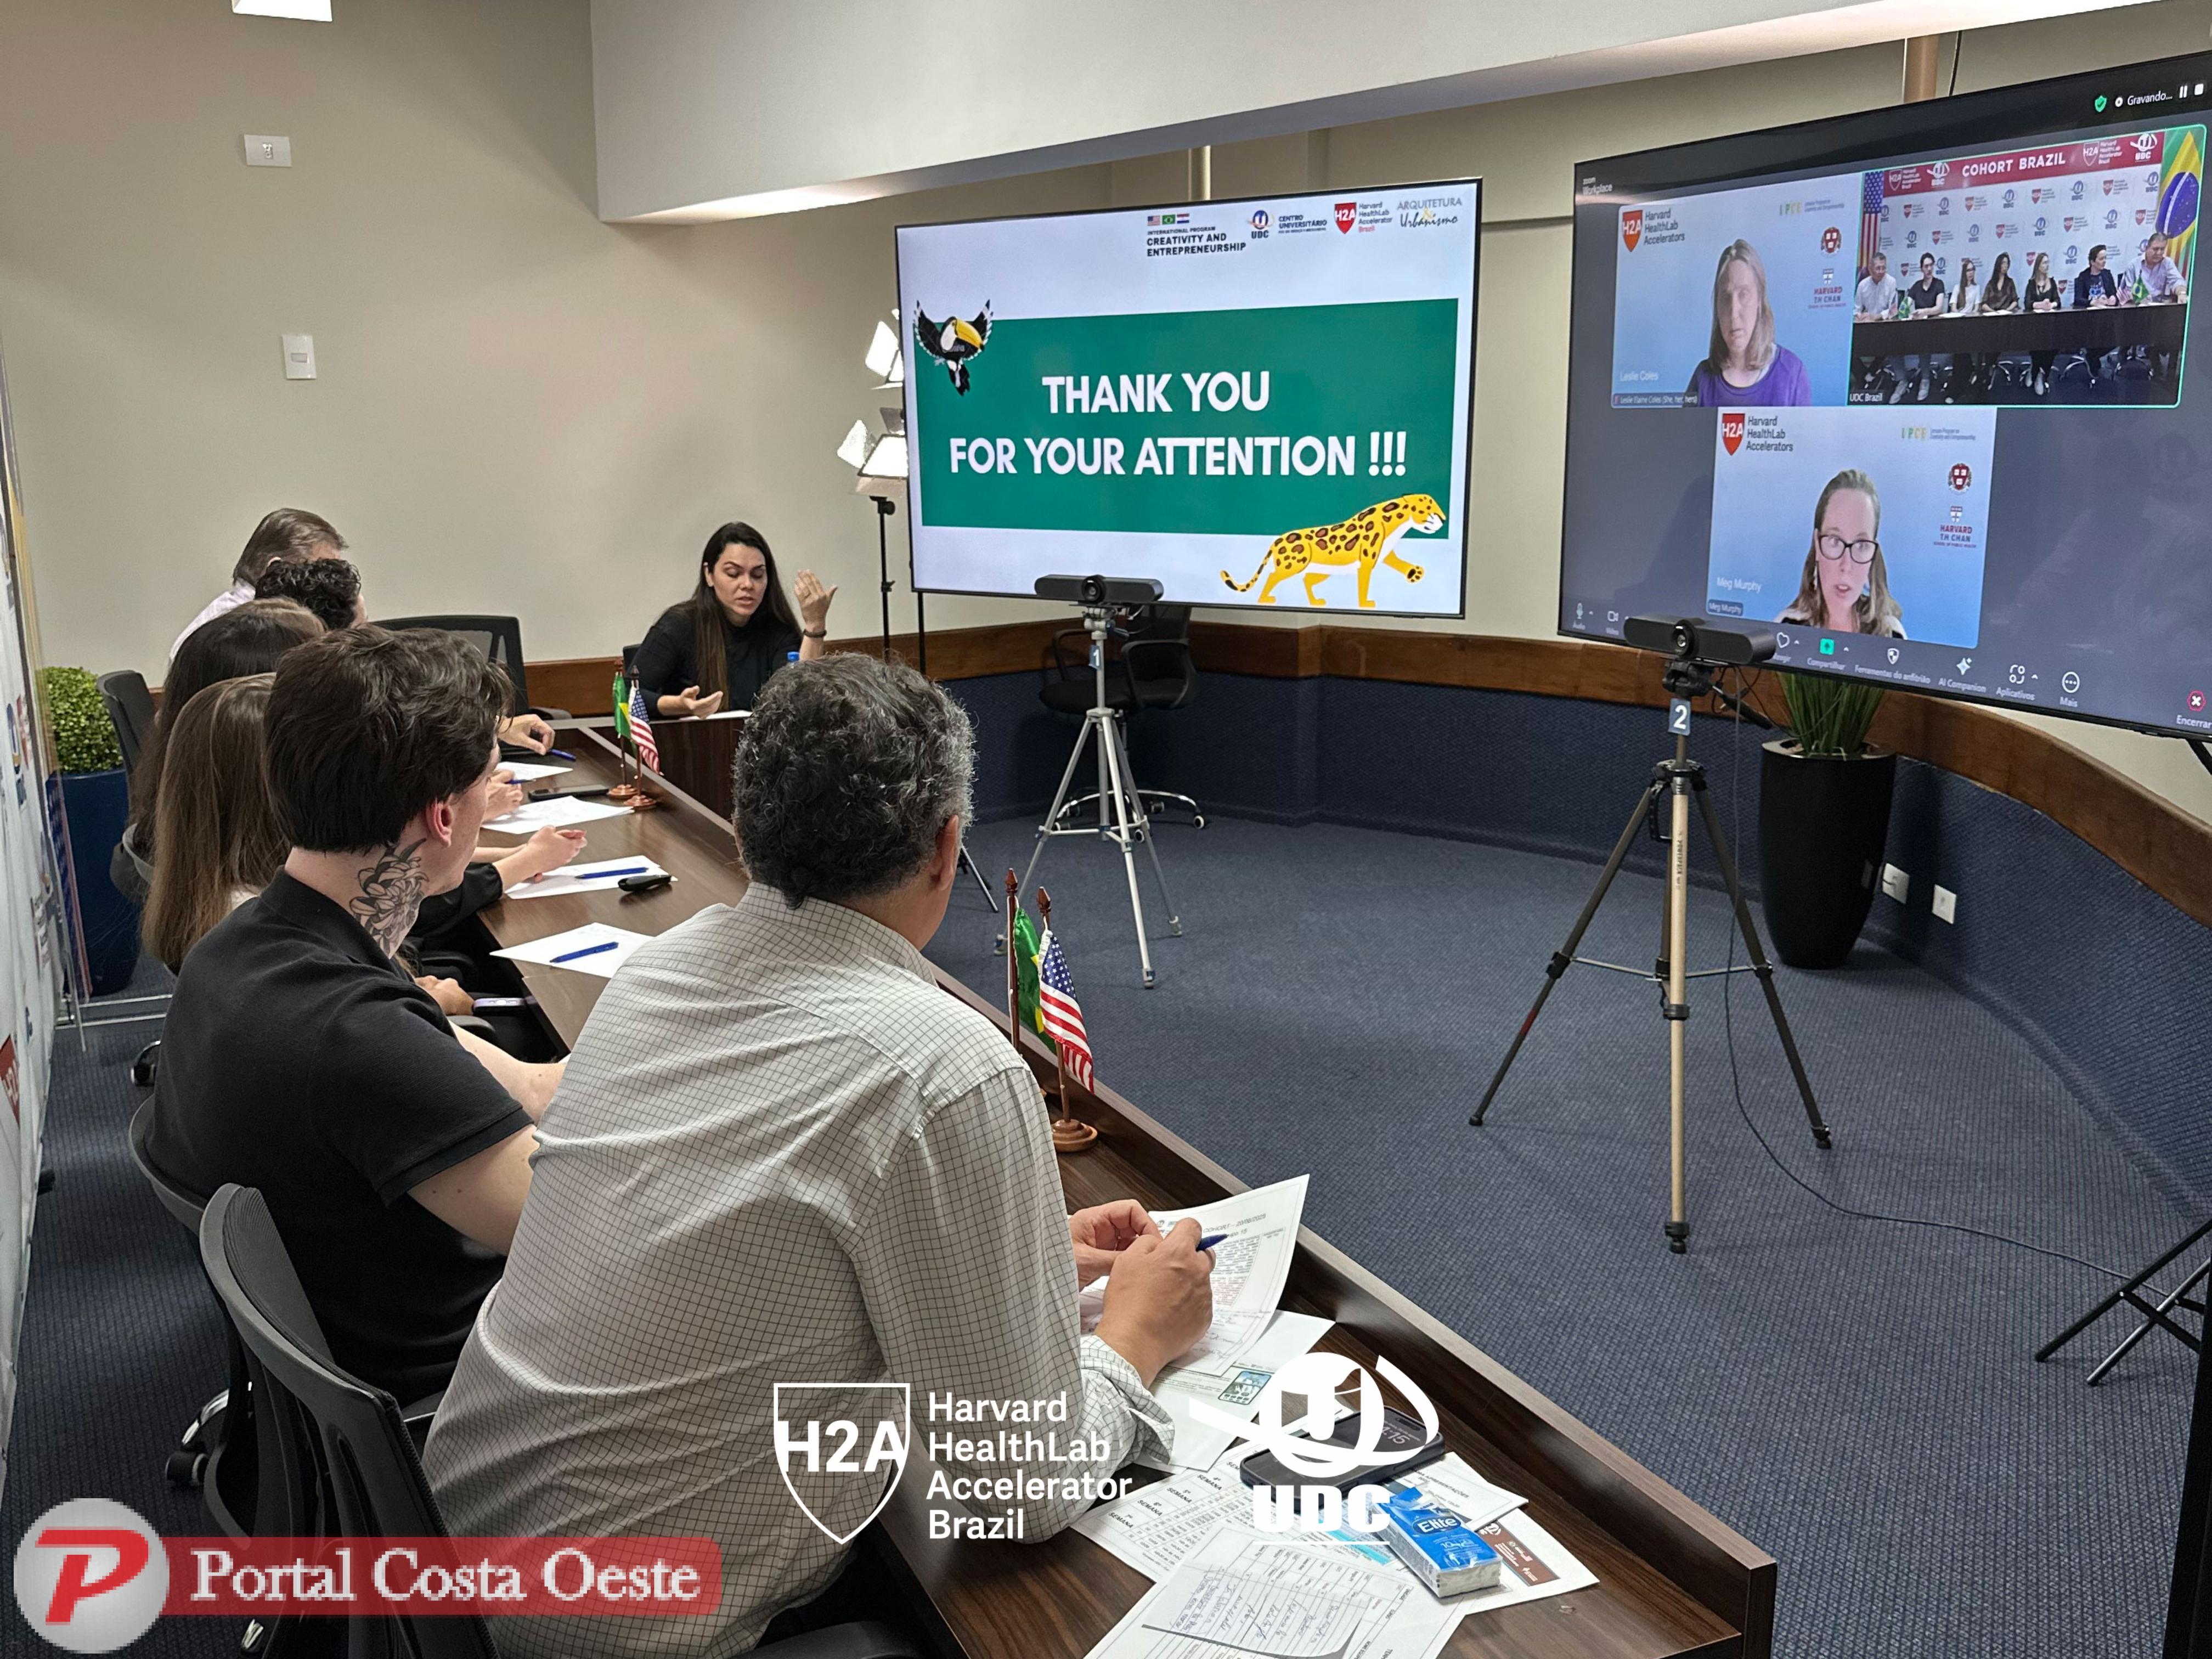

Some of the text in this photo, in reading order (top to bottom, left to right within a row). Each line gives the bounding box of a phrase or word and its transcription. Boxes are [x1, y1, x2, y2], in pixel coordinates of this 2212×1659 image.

[1962, 153, 2066, 177] COHORT BRAZIL
[1359, 201, 1383, 210] Harvard
[1397, 198, 1463, 211] ARQUITETURA
[1334, 208, 1356, 222] H2A
[1358, 209, 1390, 217] HealthLab
[1400, 212, 1459, 228] Urbanismo
[1645, 208, 1672, 219] Harvard
[1622, 219, 1642, 236] H2A
[1645, 221, 1679, 233] HealthLab
[1147, 233, 1227, 246] CREATIVITY AND
[1251, 230, 1269, 239] UDC
[1644, 233, 1685, 245] Accelerators
[1147, 242, 1246, 257] ENTREPRENEURSHIP
[1814, 286, 1843, 295] HARVARD
[1042, 371, 1270, 414] THANK YOU
[1849, 393, 1883, 402] UDC Brazil
[1748, 415, 1778, 426] Harvard
[1722, 422, 1743, 438] H2A
[1747, 428, 1786, 439] HealthLab
[1746, 441, 1793, 452] Accelerators
[950, 432, 1406, 476] FOR YOUR ATTENTION !!!
[1940, 524, 1973, 534] HARVARD
[1717, 577, 1762, 594] Meg Murphy
[1092, 649, 1100, 666] 1
[1948, 679, 1987, 693] Companion
[1996, 687, 2035, 701] Aplicativos
[2059, 697, 2078, 708] Mais
[1673, 704, 1687, 730] 2
[2176, 714, 2212, 729] Encerrar
[1198, 1474, 1222, 1491] SEMANA
[1166, 1487, 1192, 1503] SEMANA
[1137, 1499, 1163, 1516] SEMANA
[1109, 1512, 1134, 1528] SEMANA
[1417, 1516, 1458, 1533] Elite
